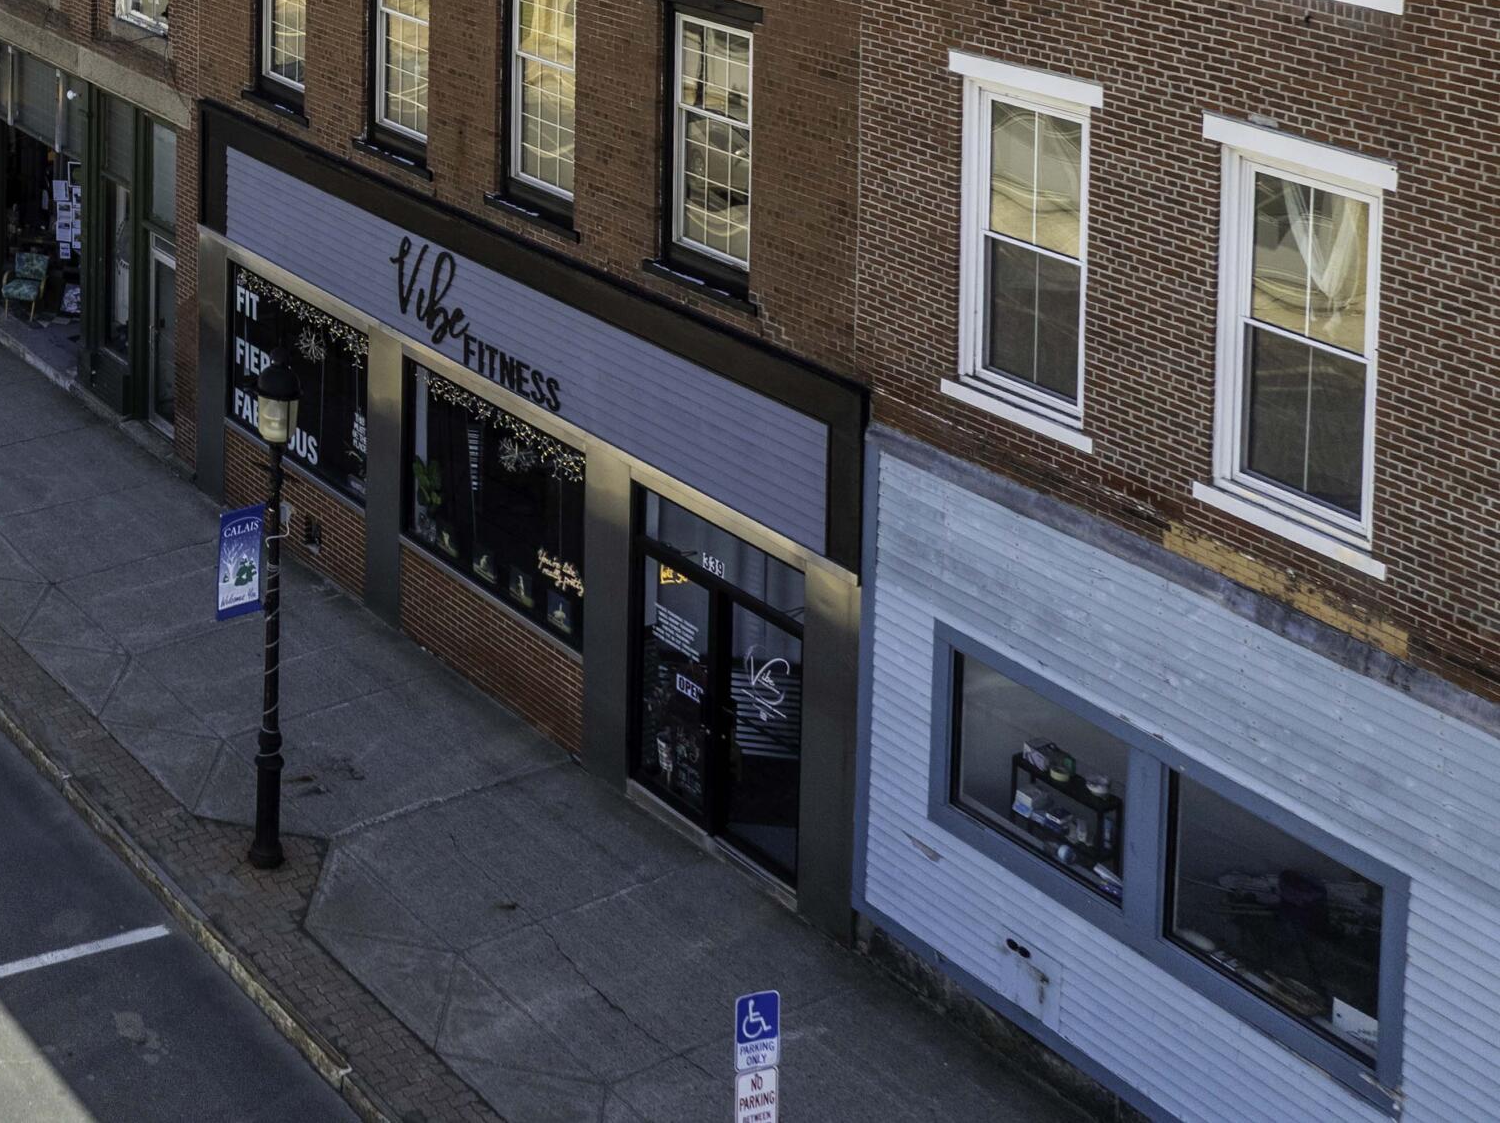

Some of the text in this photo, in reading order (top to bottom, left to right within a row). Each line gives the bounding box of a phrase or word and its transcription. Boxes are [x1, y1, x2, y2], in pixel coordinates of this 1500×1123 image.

[389, 236, 470, 344] Vibe
[236, 284, 260, 321] FIT
[463, 333, 561, 412] FITNESS
[223, 520, 260, 538] CALAIS
[537, 548, 561, 569] You're
[704, 556, 724, 577] 339
[542, 568, 585, 597] really pretty
[750, 656, 790, 687] Vibe
[739, 1040, 776, 1056] PARKING
[746, 1054, 768, 1067] ONLY
[750, 1075, 764, 1092] NO
[739, 1090, 776, 1112] PARKING
